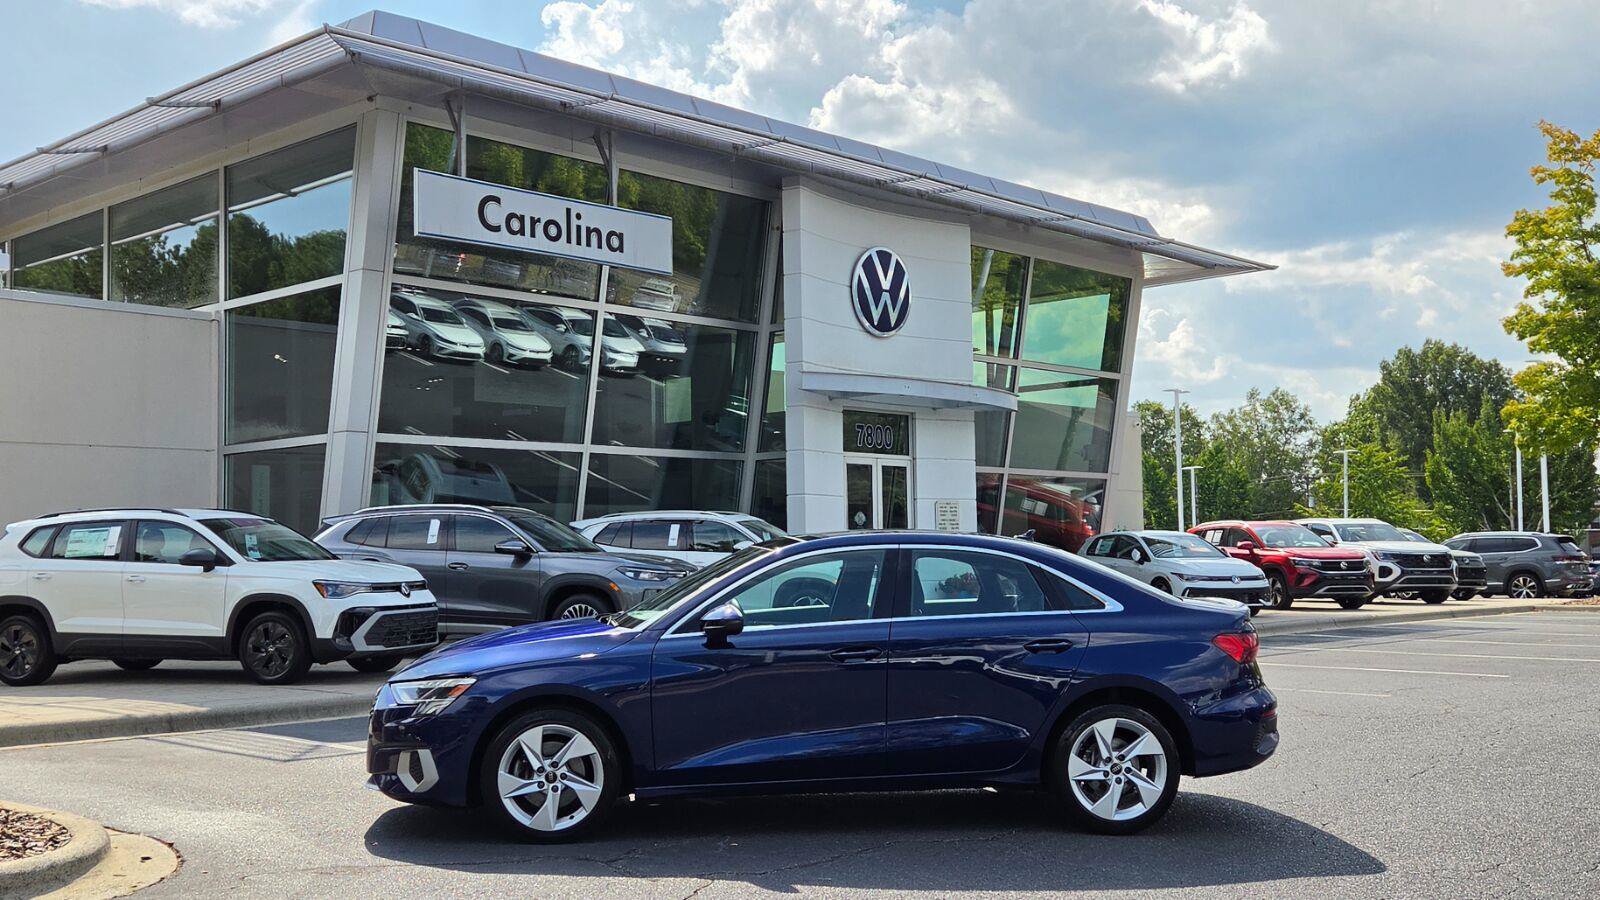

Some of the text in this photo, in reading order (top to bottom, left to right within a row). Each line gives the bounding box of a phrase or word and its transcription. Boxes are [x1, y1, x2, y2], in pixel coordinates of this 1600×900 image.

[477, 194, 624, 253] Carolina
[855, 248, 910, 330] VW
[855, 423, 893, 449] 7800
